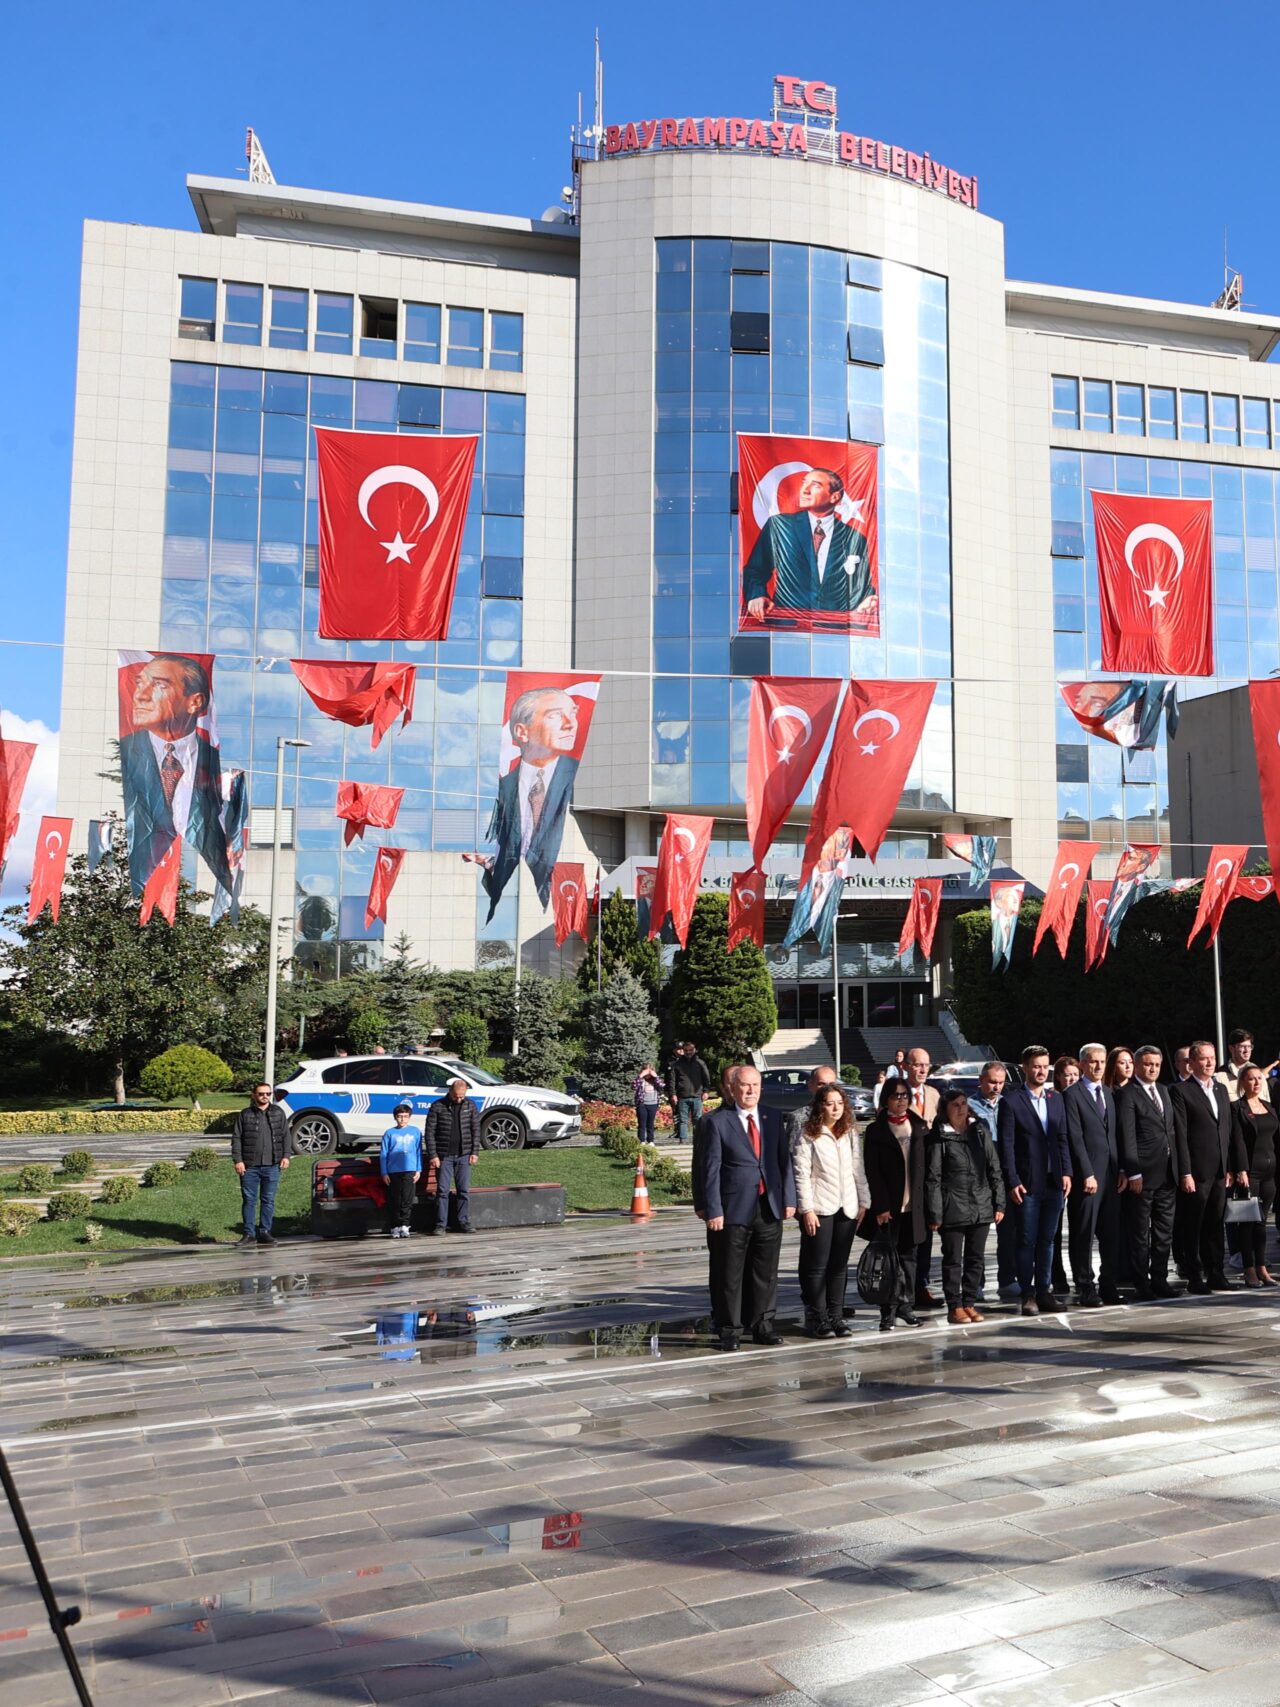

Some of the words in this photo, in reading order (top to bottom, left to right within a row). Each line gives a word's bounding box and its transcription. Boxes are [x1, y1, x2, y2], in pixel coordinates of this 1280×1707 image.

[775, 75, 837, 114] T.C.
[606, 117, 809, 156] BAYRAMPAŞA
[839, 131, 979, 209] BELEDİYESİ
[844, 872, 880, 888] EDİYE
